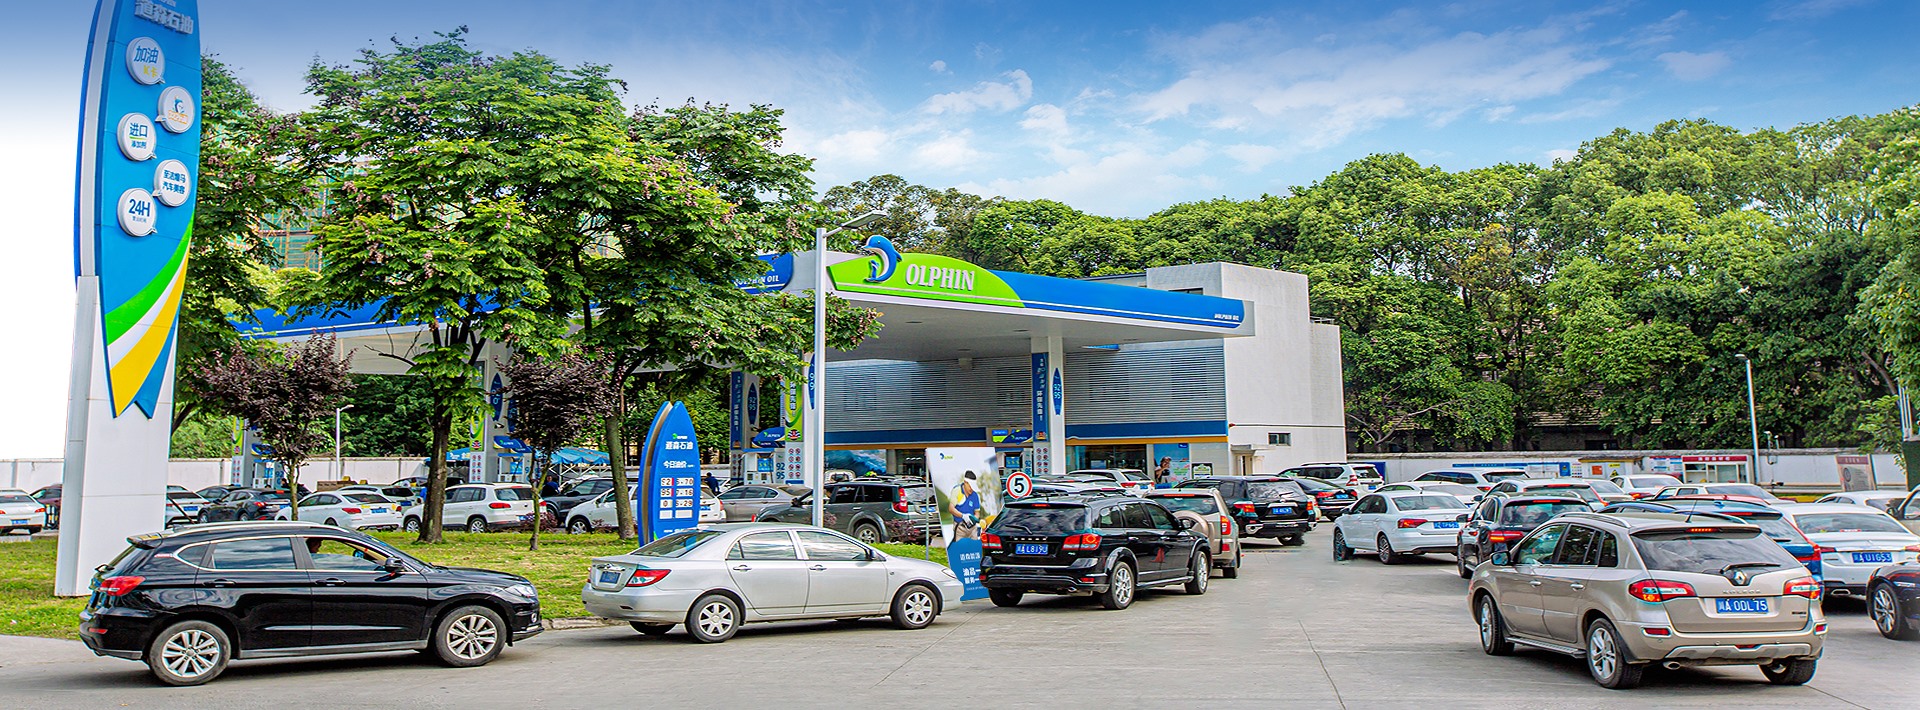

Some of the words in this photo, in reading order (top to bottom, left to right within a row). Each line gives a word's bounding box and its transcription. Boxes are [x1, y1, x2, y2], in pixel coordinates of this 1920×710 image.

[133, 46, 159, 64] 加油
[129, 122, 148, 138] 进口
[128, 198, 151, 217] 24H
[766, 274, 780, 284] OIL
[775, 462, 786, 471] 92
[775, 471, 786, 480] 95
[661, 488, 672, 496] 95
[1013, 477, 1025, 494] 5
